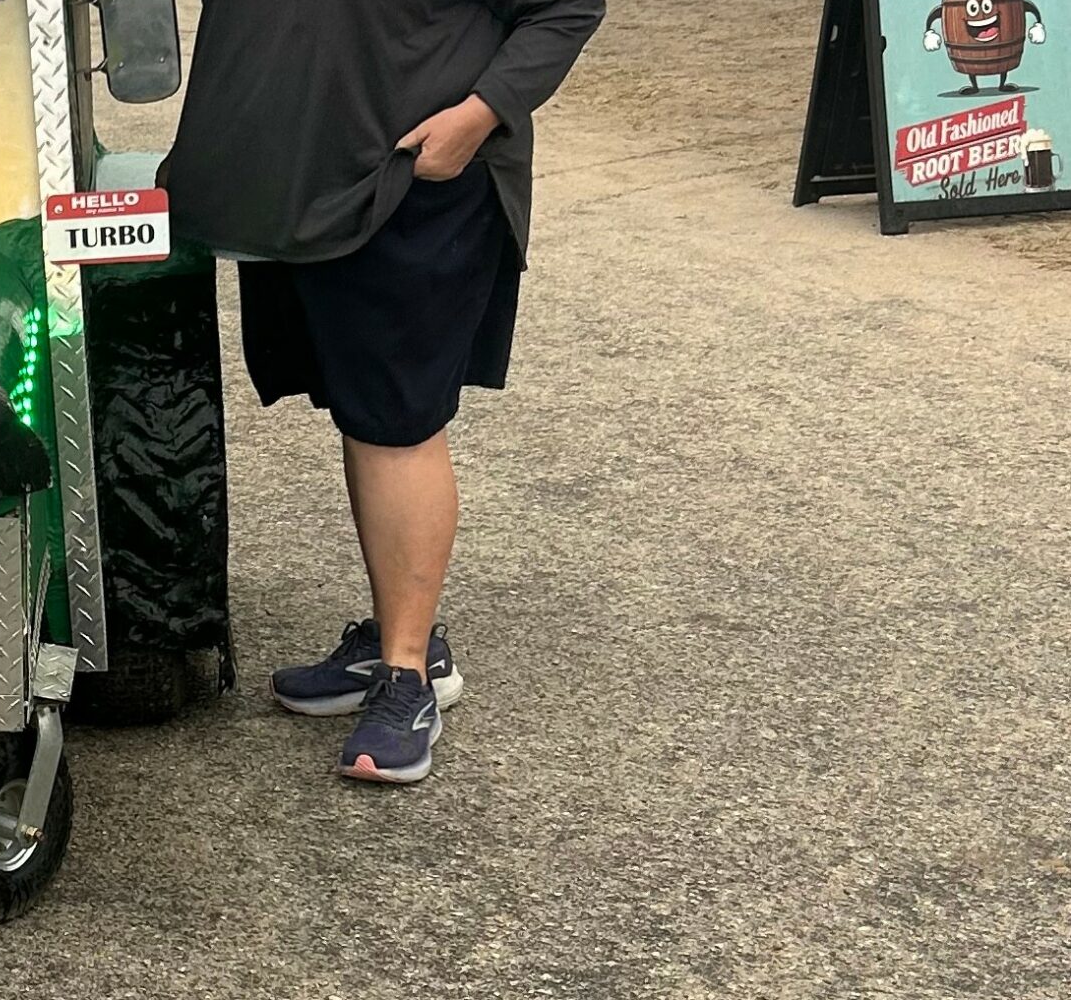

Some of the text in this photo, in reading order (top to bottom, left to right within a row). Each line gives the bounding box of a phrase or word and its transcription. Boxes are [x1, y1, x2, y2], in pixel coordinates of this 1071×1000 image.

[906, 101, 1019, 153] Old Fashioned
[911, 134, 1023, 185] ROOT BEER
[938, 167, 1022, 200] Sold Here
[71, 192, 139, 209] HELLO
[65, 223, 155, 249] TURBO
